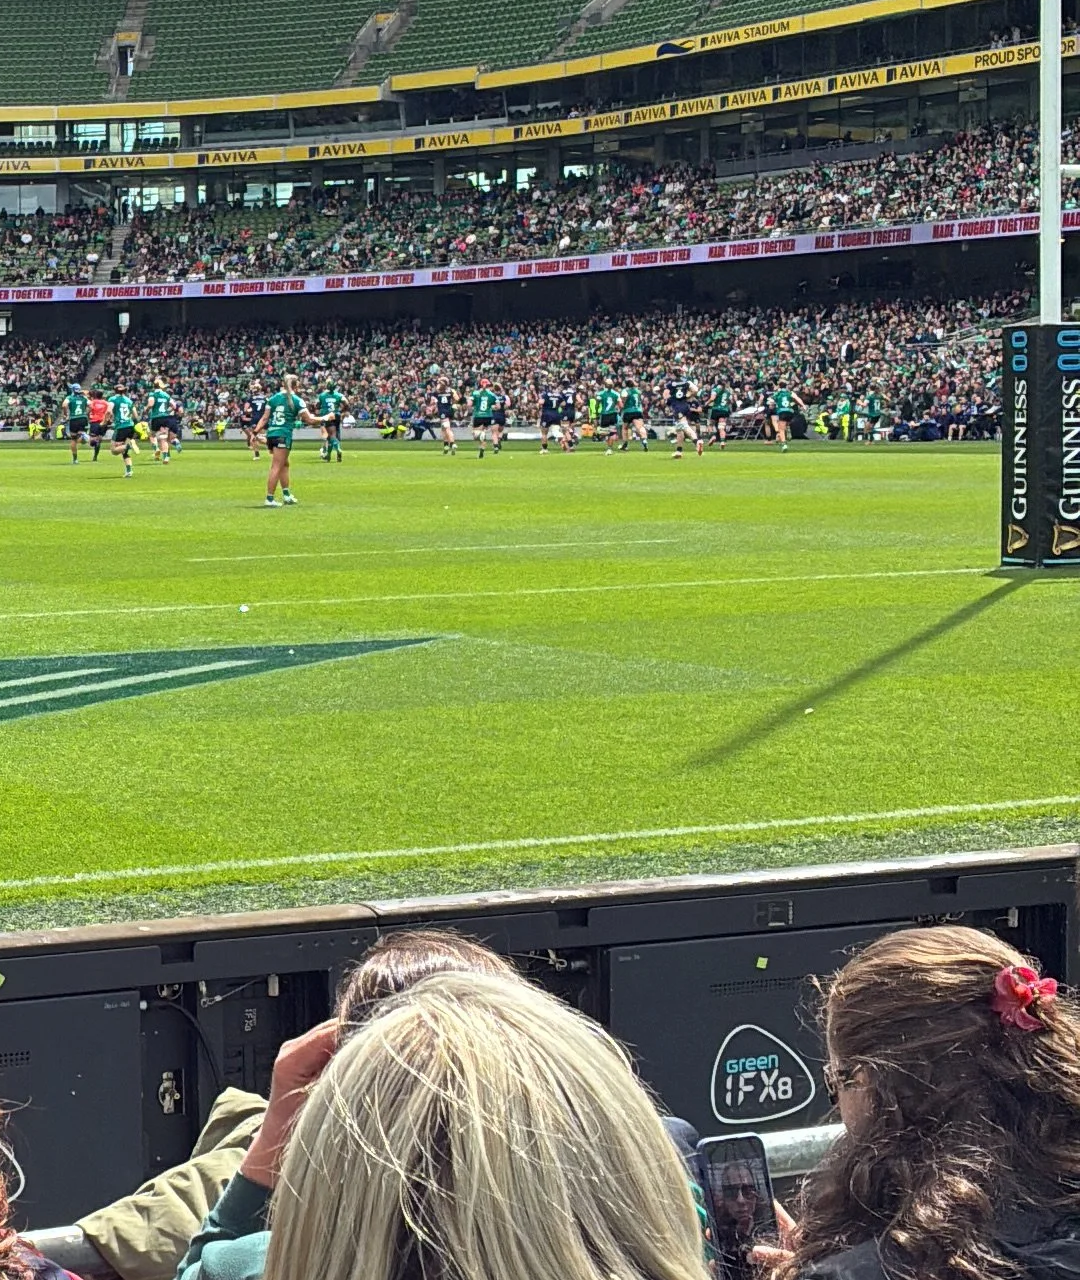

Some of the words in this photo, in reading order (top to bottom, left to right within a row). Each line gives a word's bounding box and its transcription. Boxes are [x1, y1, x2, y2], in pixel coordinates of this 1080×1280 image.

[710, 29, 740, 46] AVIVA
[744, 21, 791, 40] STADIUM
[974, 49, 1017, 69] PROUD
[1017, 38, 1076, 61] SPOOR
[900, 61, 942, 79] AVIVA
[784, 81, 822, 98] AVIVA
[840, 73, 879, 89] AVIVA
[731, 90, 767, 107] AVIVA
[633, 106, 667, 123] AVIVA
[680, 99, 715, 116] AVIVA
[525, 123, 562, 138] AVIVA
[592, 114, 621, 130] AVIVA
[428, 133, 469, 147] AVIVA
[212, 151, 258, 163] AVIVA
[322, 143, 367, 157] AVIVA
[98, 156, 145, 168] AVIVA
[932, 223, 955, 239] MADE
[957, 220, 995, 236] TOUGHER
[997, 215, 1040, 234] TOGETHER
[1062, 212, 1080, 228] MAD
[815, 236, 835, 250] MADE
[837, 232, 871, 248] TOUGHER
[873, 228, 911, 244] TOGETHER
[708, 246, 726, 259] MADE
[728, 243, 759, 258] TOUGHER
[761, 238, 796, 254] TOGETHER
[612, 253, 628, 267] MADE
[630, 251, 658, 265] TOUGHER
[660, 248, 691, 263] TOGETHER
[431, 271, 450, 283] MADE
[451, 268, 477, 281] TOUGHER
[478, 266, 504, 278] TOGETHER
[517, 263, 533, 276] MADE
[534, 261, 559, 274] TOUGHER
[561, 258, 590, 272] TOGETHER
[203, 284, 225, 295] MADE
[229, 282, 264, 294] TOUGHER
[266, 280, 305, 292] TOGETHER
[325, 278, 345, 290] MADE
[347, 275, 380, 288] TOUGHER
[382, 273, 415, 286] TOGETHER
[11, 289, 53, 299] TOGETHER
[76, 287, 98, 298] MADE
[102, 286, 140, 297] TOUGHER
[142, 285, 183, 296] TOGETHER
[1012, 331, 1027, 372] 0.0
[1057, 330, 1080, 372] 0.0
[1012, 377, 1027, 520] GUINNESS
[726, 1055, 778, 1074] Green
